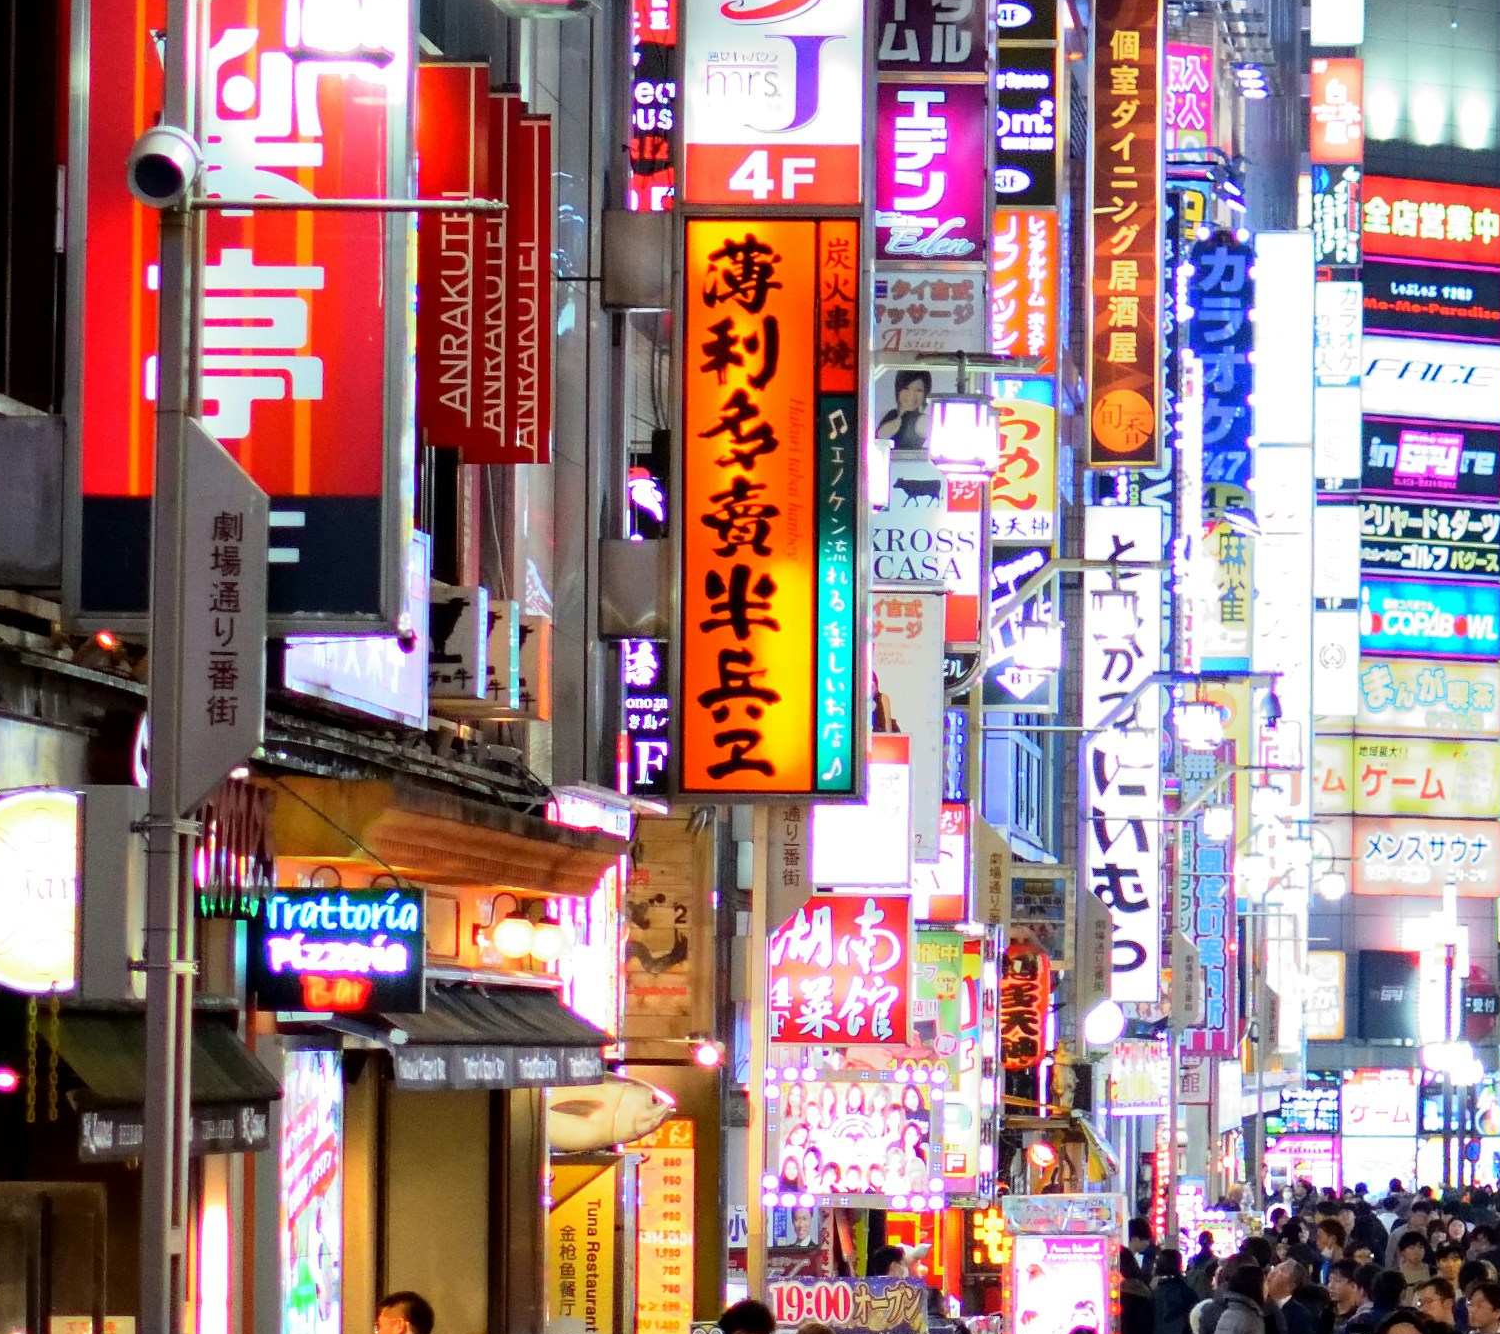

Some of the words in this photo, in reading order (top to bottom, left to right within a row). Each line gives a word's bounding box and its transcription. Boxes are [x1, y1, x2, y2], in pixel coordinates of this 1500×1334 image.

[894, 91, 947, 211] エデン
[729, 151, 816, 199] 4F
[1106, 29, 1140, 364] 個室ダイニング居酒屋
[885, 217, 976, 257] Eden
[1363, 195, 1500, 245] 全店営業中
[823, 239, 853, 366] 炭火串焼
[891, 279, 975, 301] タイ古式
[1364, 358, 1500, 387] FACE
[1360, 503, 1500, 543] ビリヤード&ダーツ
[874, 555, 963, 581] CASA
[207, 510, 242, 726] 劇場通り一番街
[1361, 763, 1446, 801] ゲーム
[1365, 834, 1490, 863] メンズサウナ
[265, 894, 419, 932] Trattoria
[268, 936, 408, 973] Pizzeria
[303, 975, 370, 1011] Bar
[795, 976, 900, 1042] 菜館
[1351, 1103, 1412, 1124] ゲーム
[586, 1198, 602, 1237] Tuna
[558, 1224, 578, 1318] 金枪鱼餐厅
[585, 1239, 602, 1333] Restaurant
[772, 1283, 851, 1323] 19:00
[854, 1285, 923, 1324] オープン
